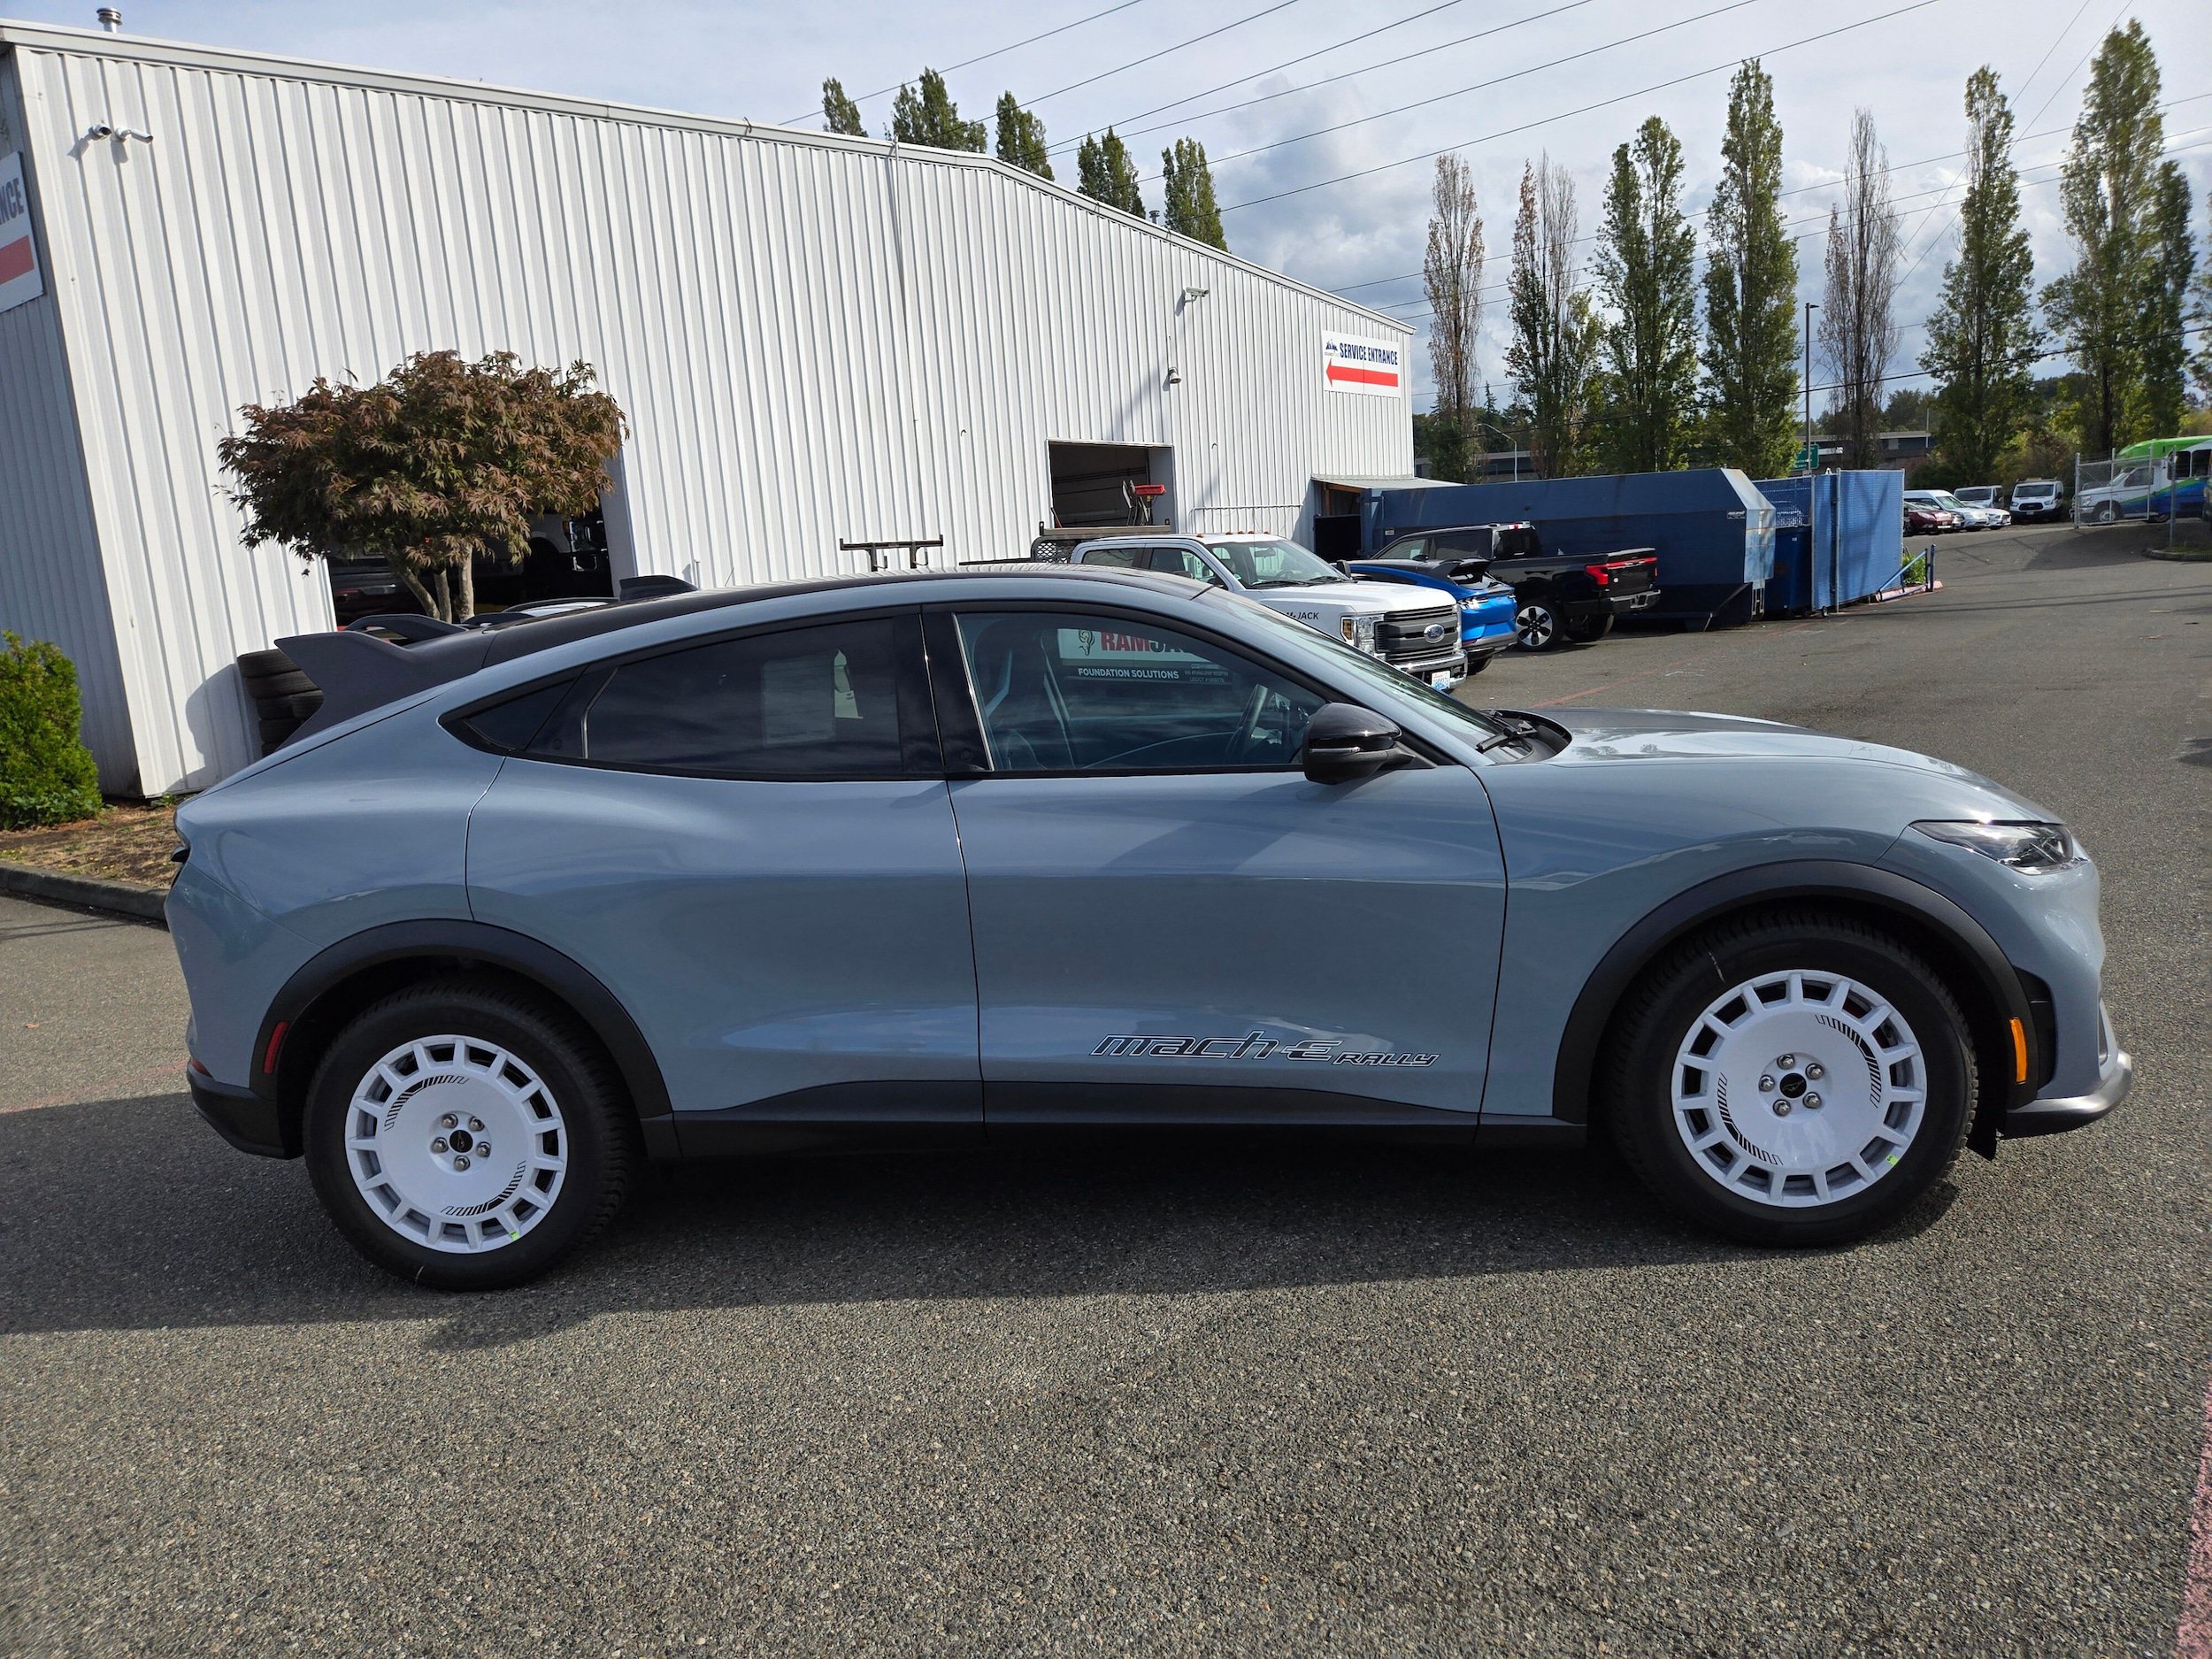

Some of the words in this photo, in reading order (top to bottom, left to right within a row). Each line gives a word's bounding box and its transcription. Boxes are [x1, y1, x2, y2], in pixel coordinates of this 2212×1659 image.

[0, 178, 24, 225] NCE
[1340, 342, 1366, 360] SERVICE
[1367, 347, 1397, 365] ENTRANCE
[1078, 668, 1130, 678] FOUNDATION
[1131, 669, 1179, 680] SOLUTIONS
[1332, 1052, 1440, 1067] RALLY
